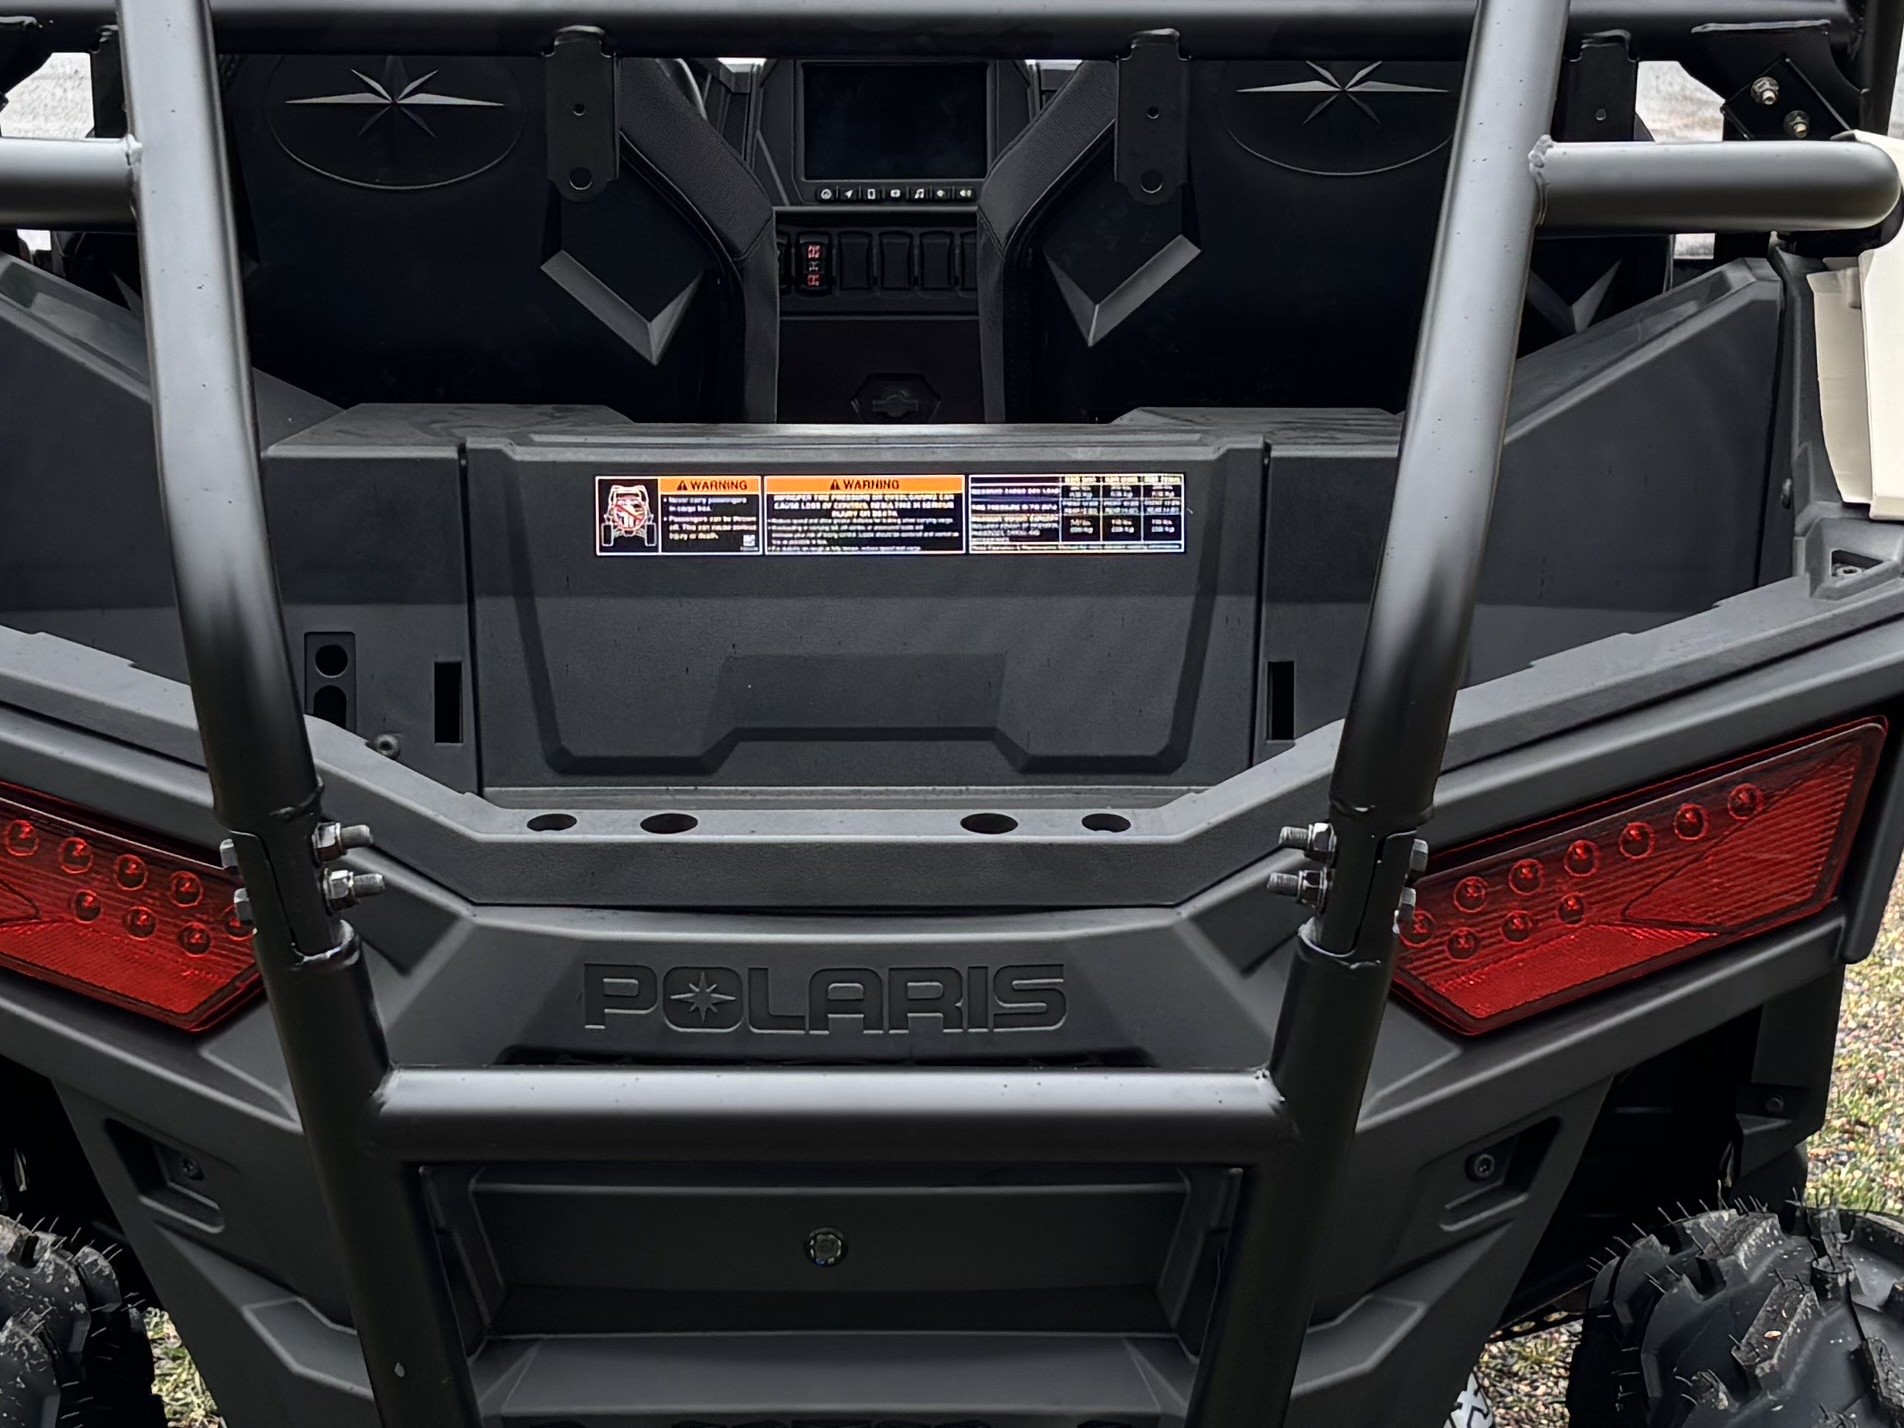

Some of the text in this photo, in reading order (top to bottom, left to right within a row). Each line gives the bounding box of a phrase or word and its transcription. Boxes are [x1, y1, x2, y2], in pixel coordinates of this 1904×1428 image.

[691, 480, 747, 491] WARNING
[843, 480, 900, 490] WARNING
[584, 963, 1067, 1035] POLARIS
